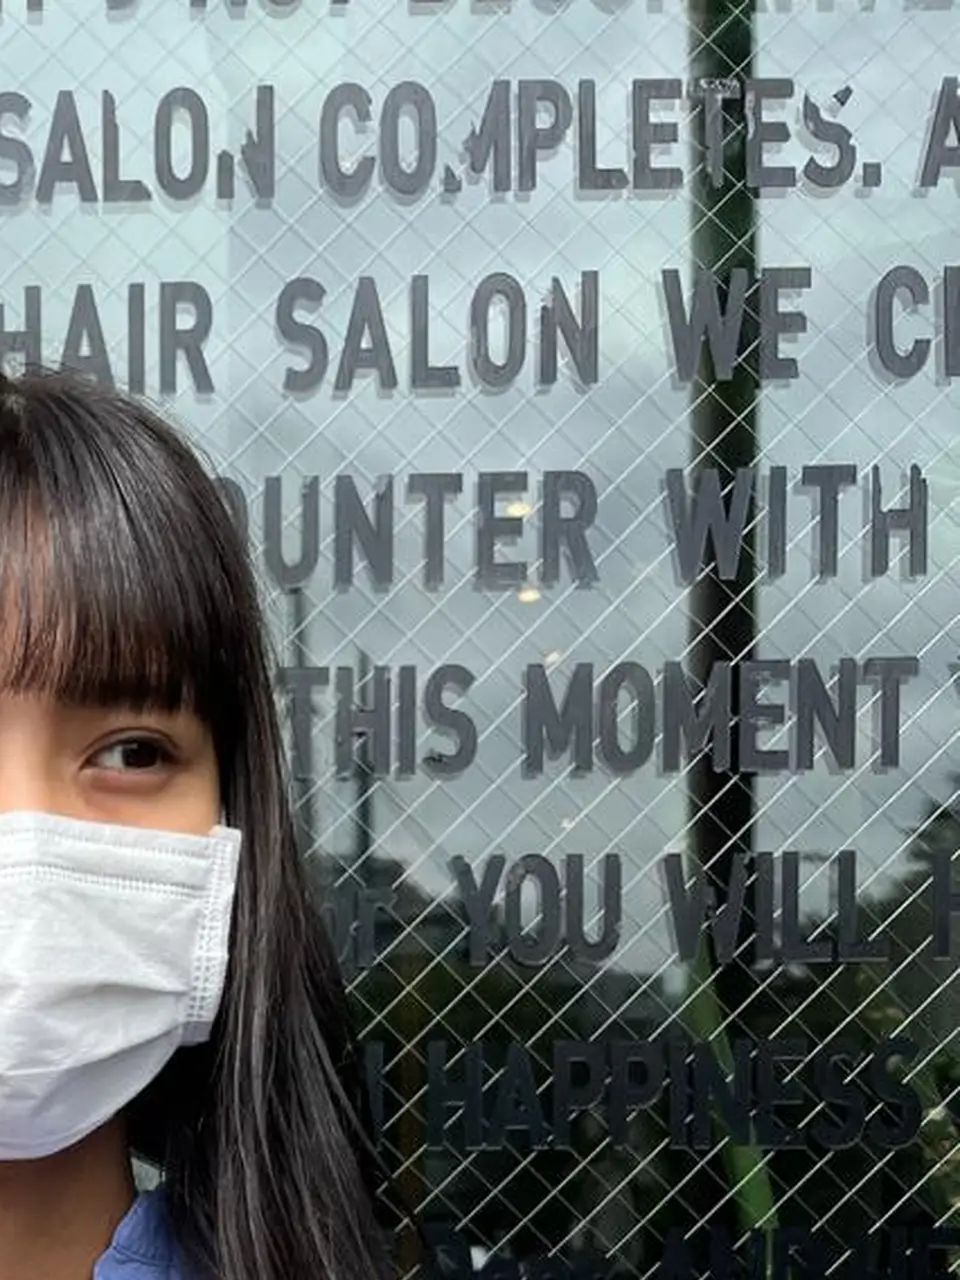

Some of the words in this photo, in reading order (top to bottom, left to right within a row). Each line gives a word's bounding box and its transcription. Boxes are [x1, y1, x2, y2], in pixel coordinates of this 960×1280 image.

[275, 271, 598, 392] SALON
[661, 266, 812, 382] WE
[876, 265, 960, 380] C
[664, 462, 928, 582] WITH
[278, 663, 478, 779] THIS
[521, 655, 919, 780] MOMENT
[447, 853, 624, 969] YOU
[662, 850, 889, 966] WILL
[426, 1038, 925, 1150] HAPPINESS
